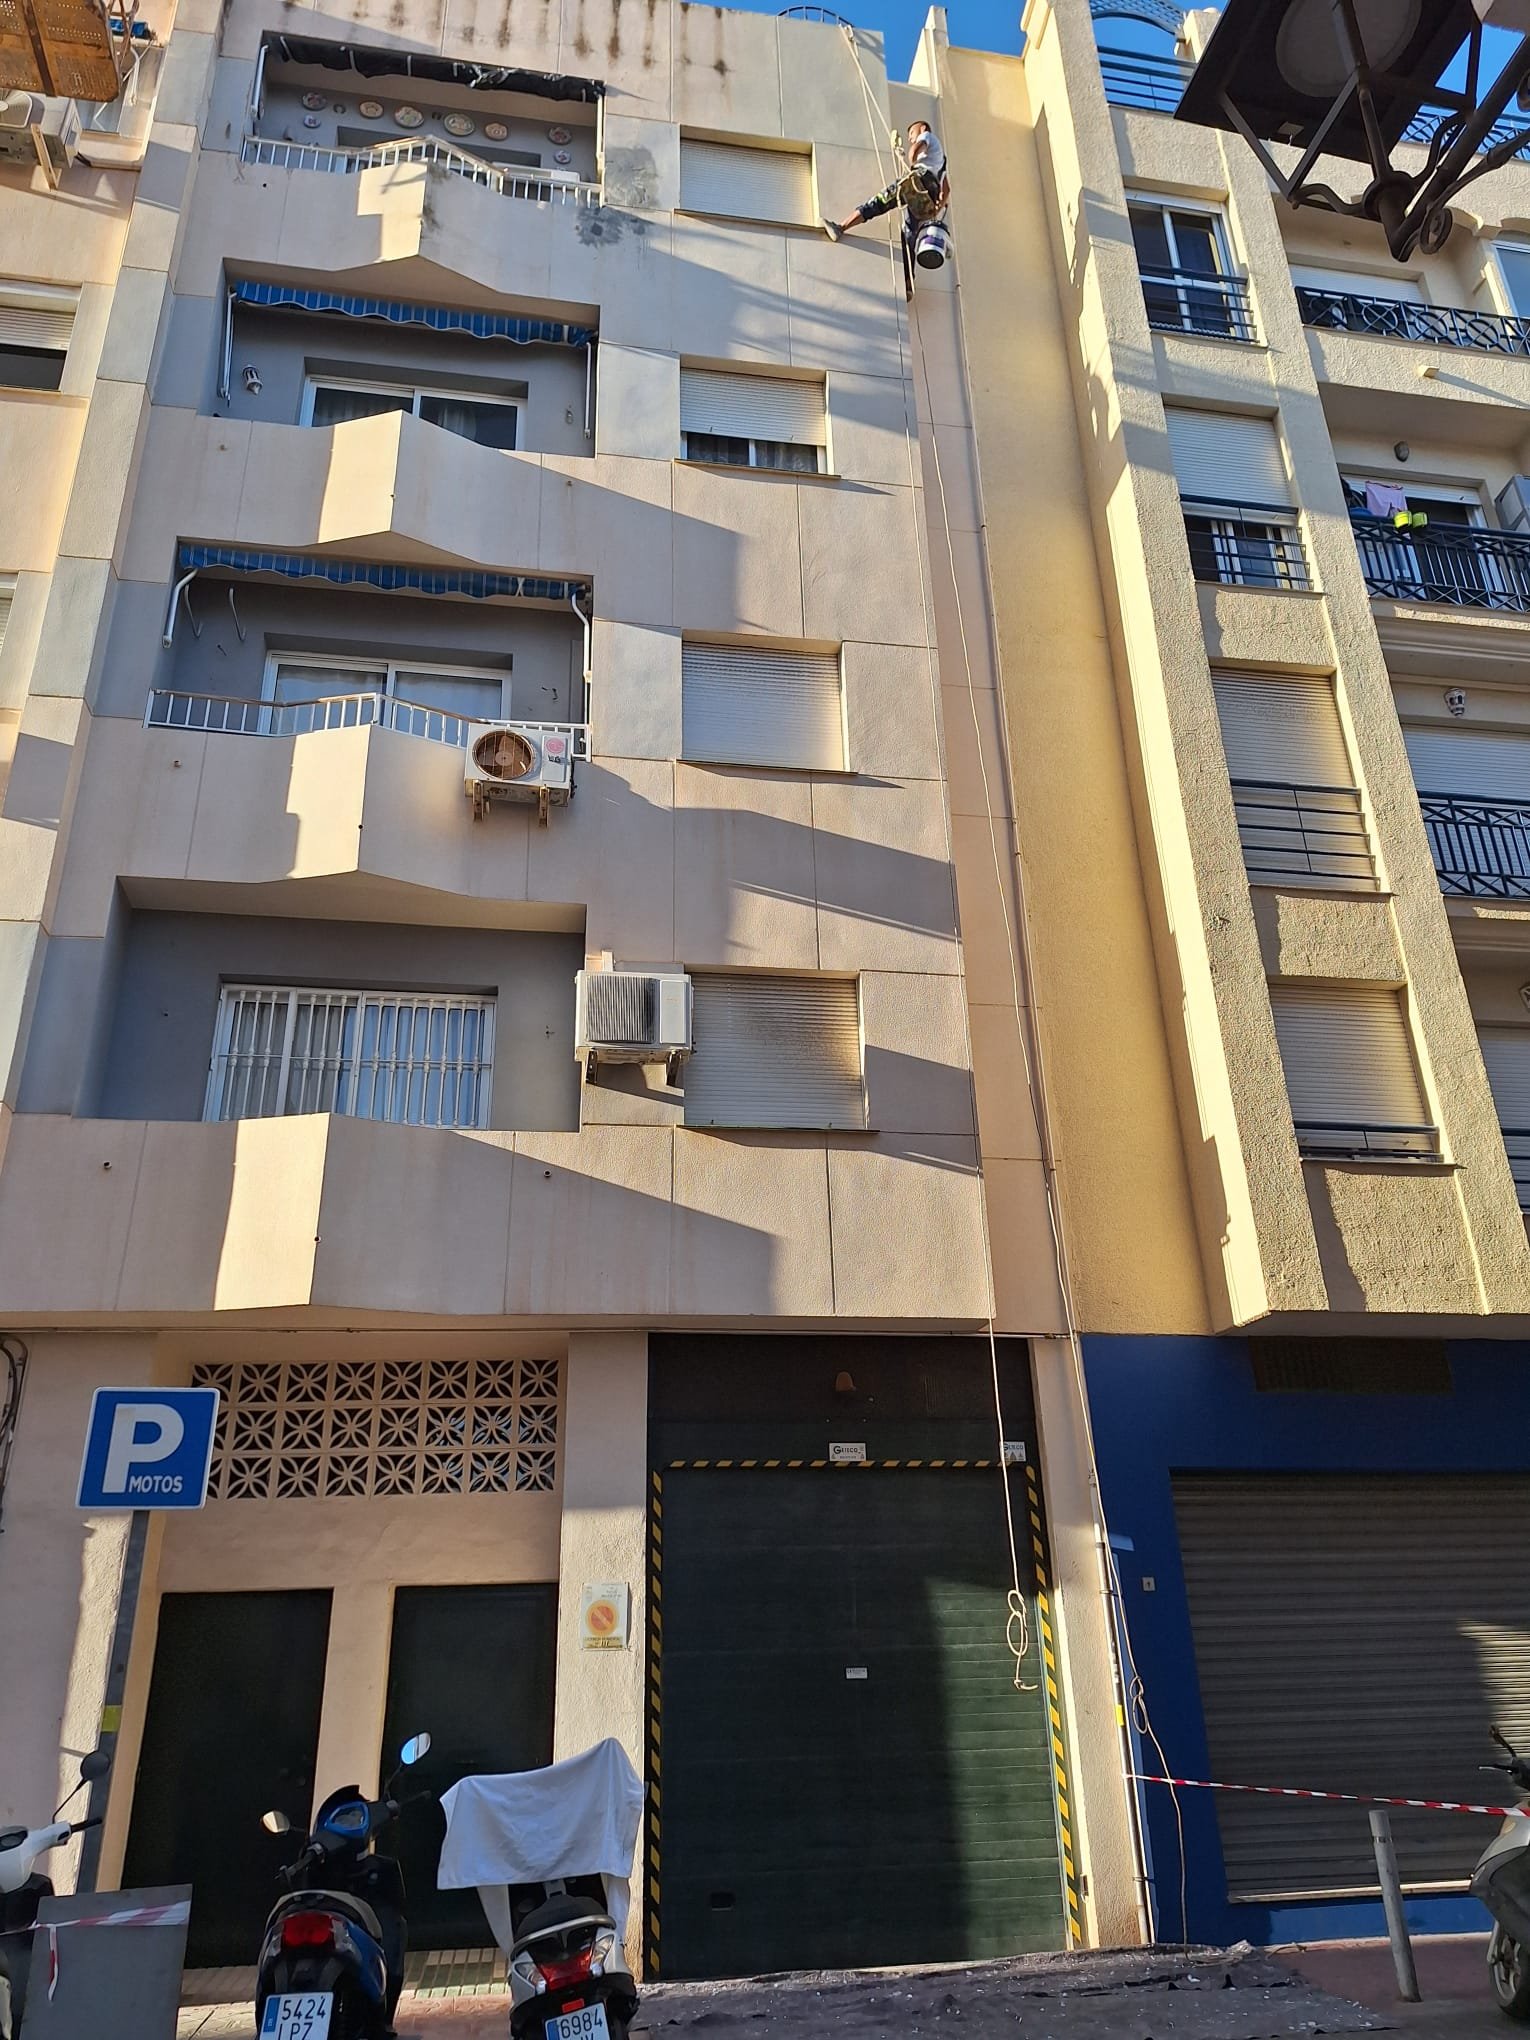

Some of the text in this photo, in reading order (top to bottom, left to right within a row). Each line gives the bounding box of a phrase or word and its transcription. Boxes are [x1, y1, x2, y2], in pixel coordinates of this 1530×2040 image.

[102, 1403, 185, 1493] P
[128, 1475, 183, 1493] MOTOS
[281, 1997, 326, 2020] 5424
[560, 2007, 602, 2039] 6984
